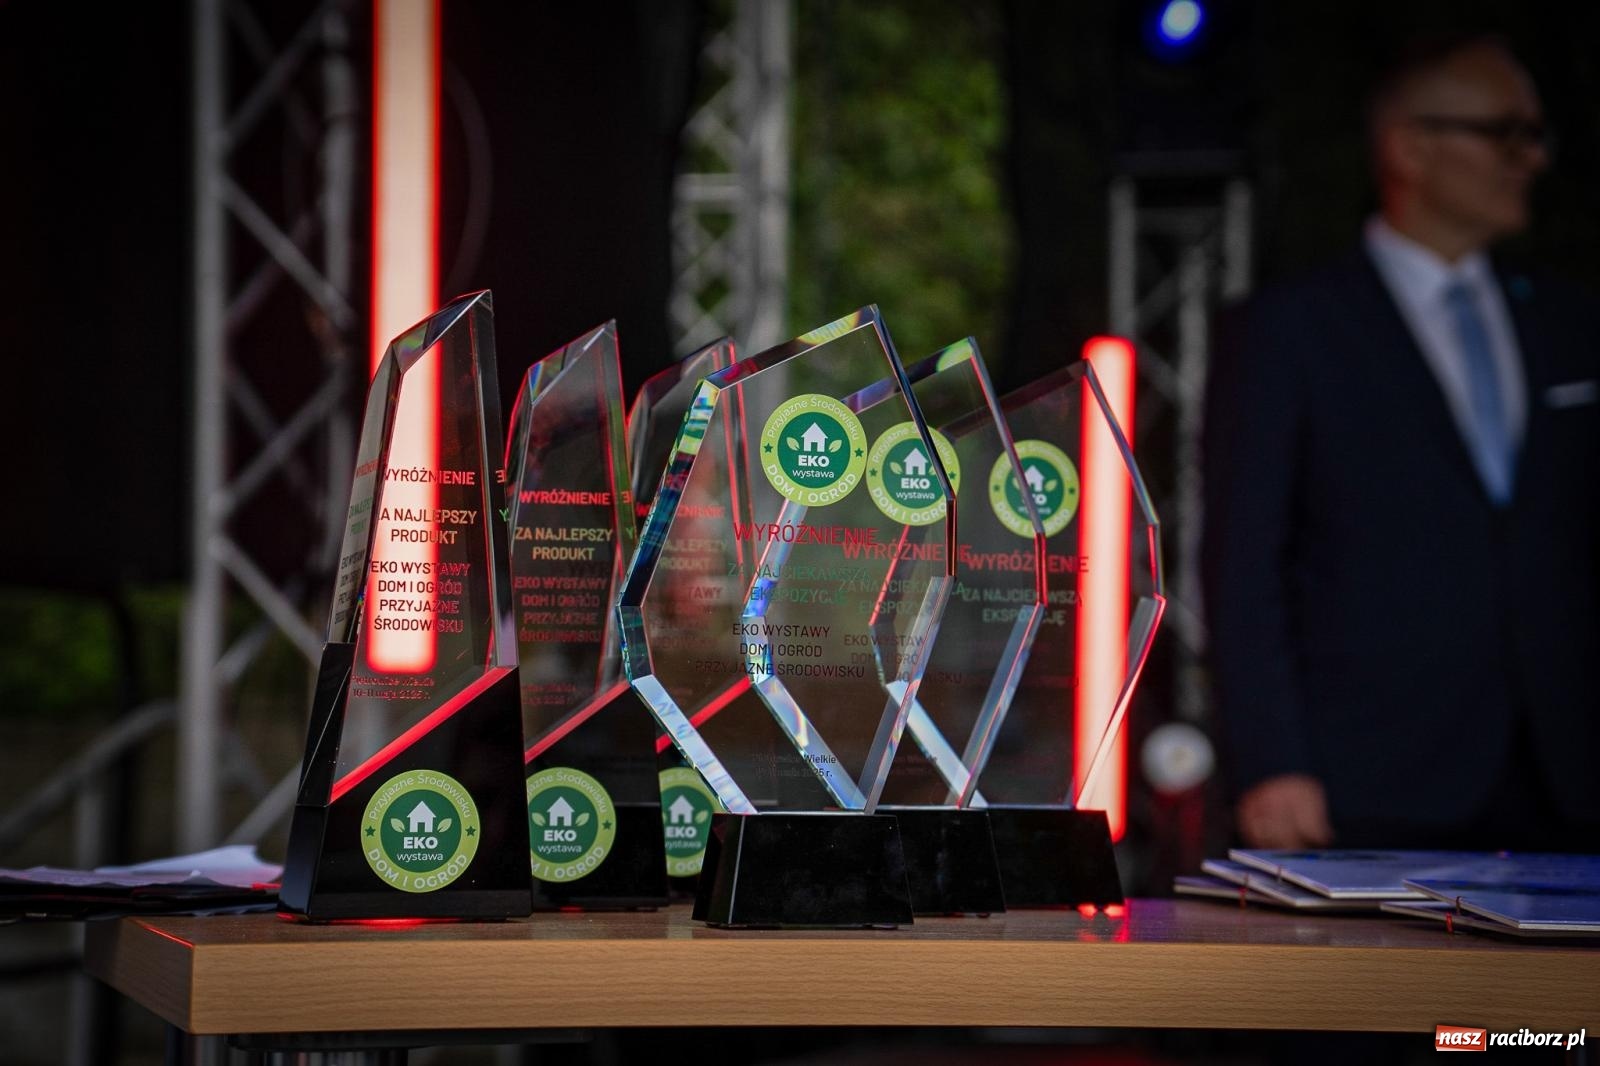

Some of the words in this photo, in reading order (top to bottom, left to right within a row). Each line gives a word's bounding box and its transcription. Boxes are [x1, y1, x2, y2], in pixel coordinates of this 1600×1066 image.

[767, 399, 808, 438] Przyjazne
[810, 394, 859, 440] Środowisku
[798, 455, 830, 467] EKO
[792, 469, 835, 478] wystawa
[767, 464, 795, 495] DOM
[798, 490, 803, 500] I
[808, 473, 856, 503] OGRÓD
[900, 477, 931, 489] EKO
[519, 489, 612, 505] WYRÓŻNIENIE
[872, 487, 898, 516] DOM
[895, 491, 935, 500] wystawa
[393, 508, 478, 525] NAJLEPSZY
[391, 529, 458, 545] PRODUKT
[515, 526, 533, 540] ZA
[535, 527, 614, 541] NAJLEPSZY
[733, 520, 880, 546] WYRÓŻNIENIE
[532, 547, 596, 561] PRODUKT
[371, 561, 398, 573] EKO
[400, 562, 471, 577] WYSTAWY
[378, 580, 406, 592] DOM
[409, 581, 413, 592] I
[417, 579, 464, 595] OGRÓD
[374, 615, 465, 633] ŚRODOWISKU
[733, 623, 759, 636] EKO
[763, 625, 831, 638] WYSTAWY
[844, 634, 869, 646] EKO
[740, 643, 767, 656] DOM
[778, 643, 823, 658] OGRÓD
[778, 661, 865, 678] ŚRODOWISKU
[804, 753, 837, 764] Wielkie
[369, 776, 415, 820] Przyjazne
[417, 771, 471, 819] Środowisku
[543, 829, 578, 842] EKO
[665, 826, 698, 838] EKO
[403, 836, 438, 849] EKO
[537, 844, 583, 854] wystawa
[397, 852, 444, 863] wystawa
[554, 846, 606, 879] OGRÓD
[368, 848, 399, 882] DOM
[402, 876, 409, 887] I
[413, 854, 468, 889] OGRÓD
